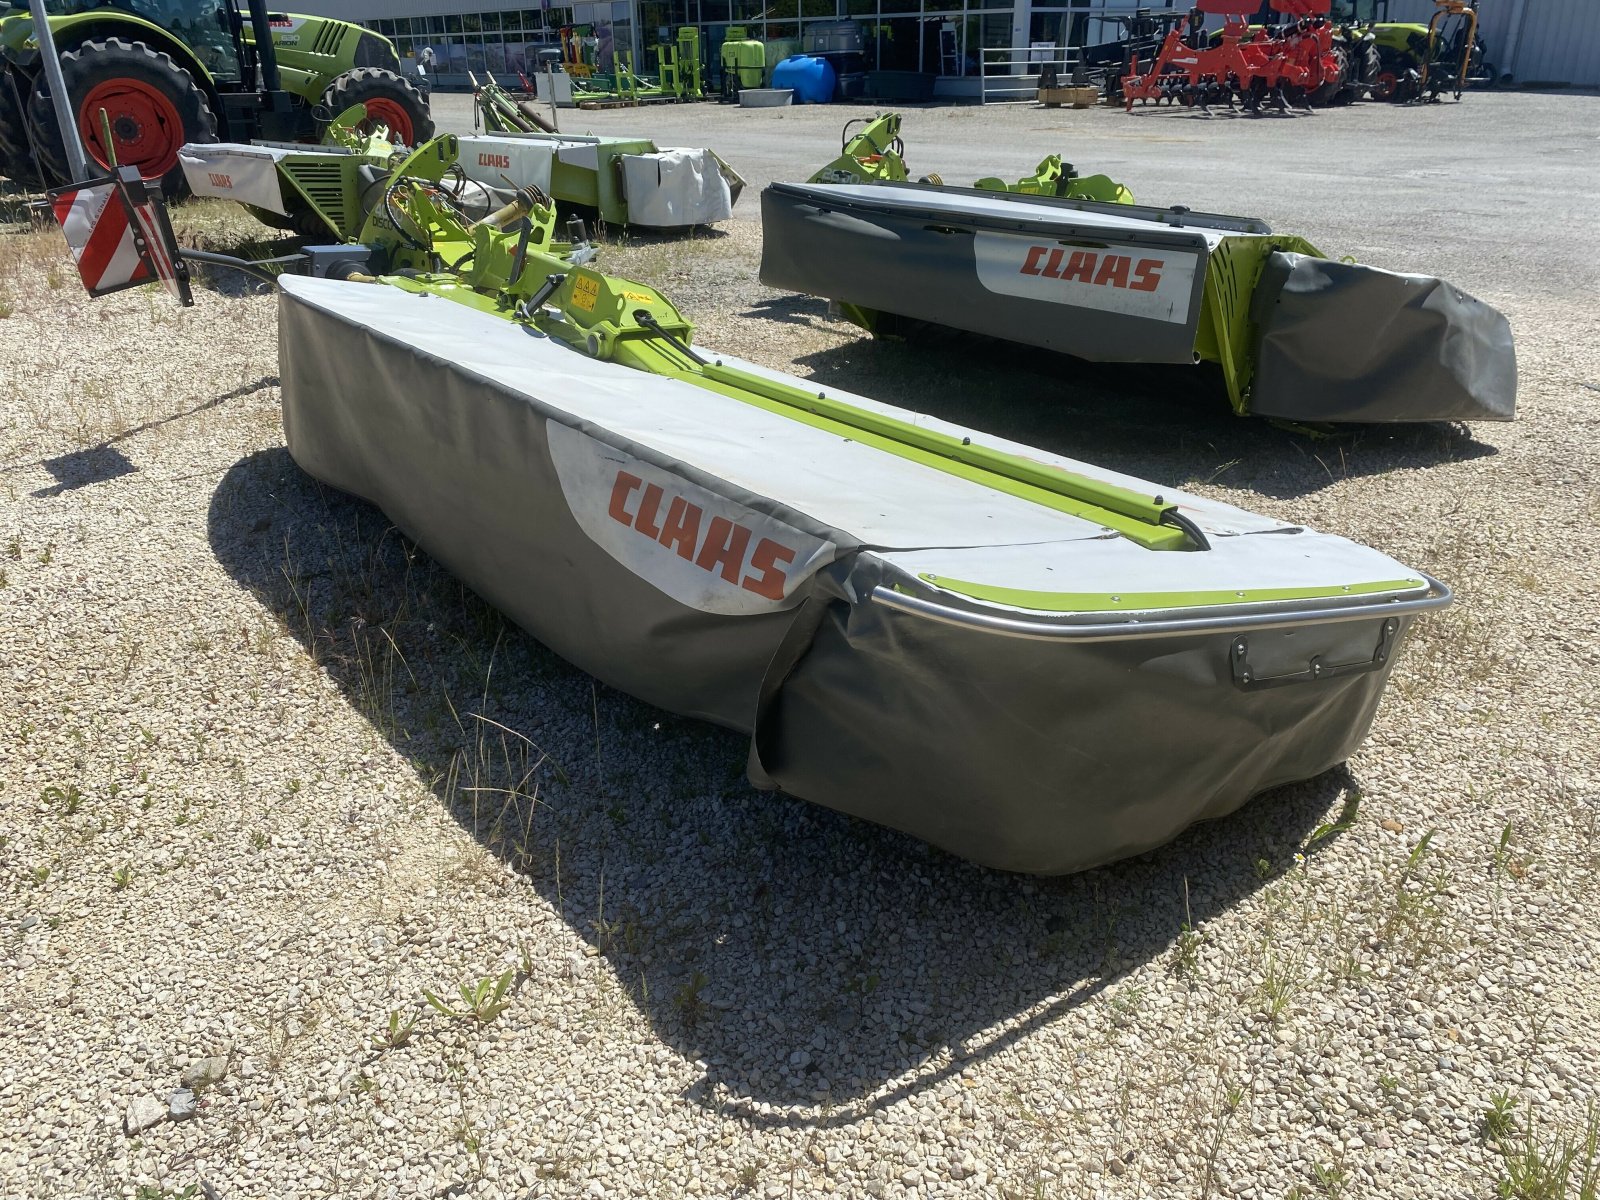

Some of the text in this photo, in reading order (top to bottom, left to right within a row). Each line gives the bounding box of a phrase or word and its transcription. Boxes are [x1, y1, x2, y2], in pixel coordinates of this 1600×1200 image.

[479, 153, 510, 169] CLAAS
[1020, 246, 1165, 292] CLAAS
[608, 470, 797, 600] CLAAS
